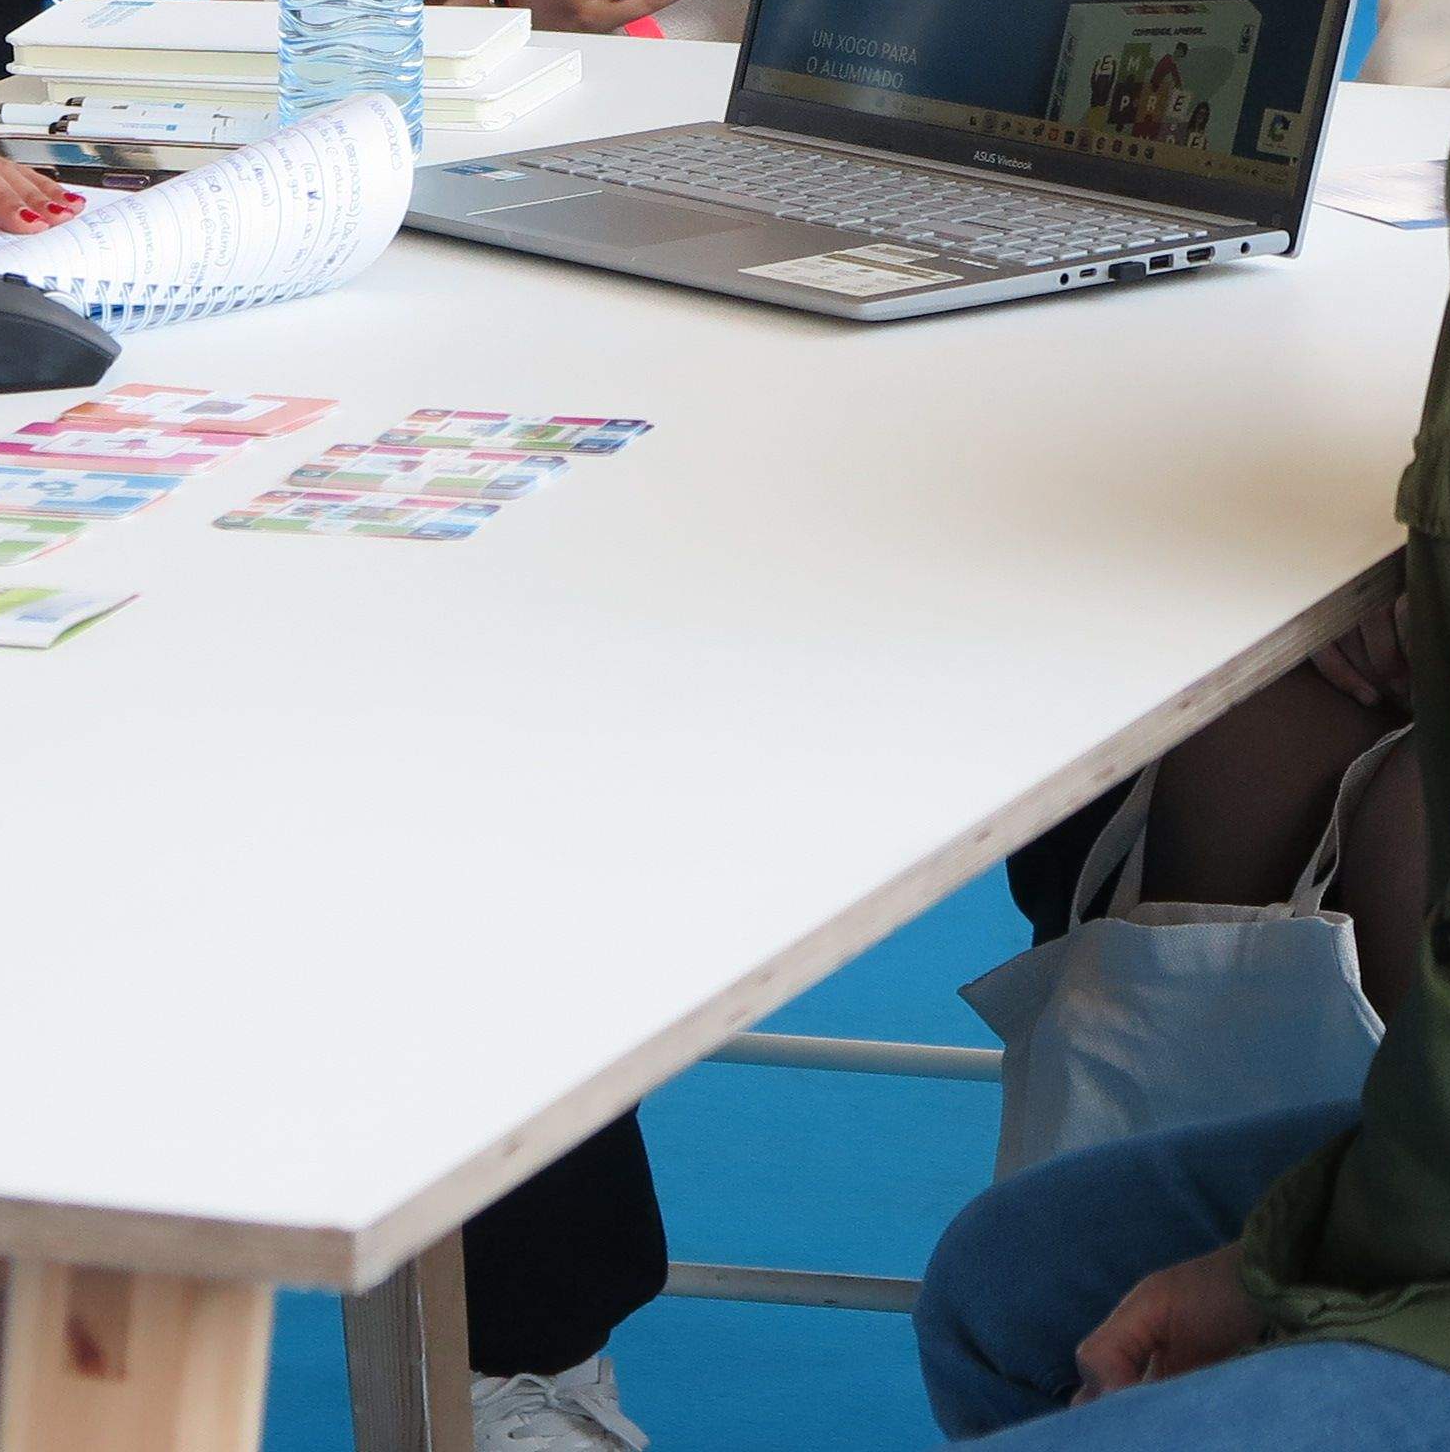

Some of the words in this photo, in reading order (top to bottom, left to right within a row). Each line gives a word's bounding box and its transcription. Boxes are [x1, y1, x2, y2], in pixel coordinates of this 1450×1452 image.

[811, 29, 834, 49] UN
[836, 35, 878, 59] XOGO
[880, 42, 918, 66] PARA
[806, 55, 819, 74] O
[819, 60, 905, 89] ALUMNADO
[972, 150, 996, 164] ASUS
